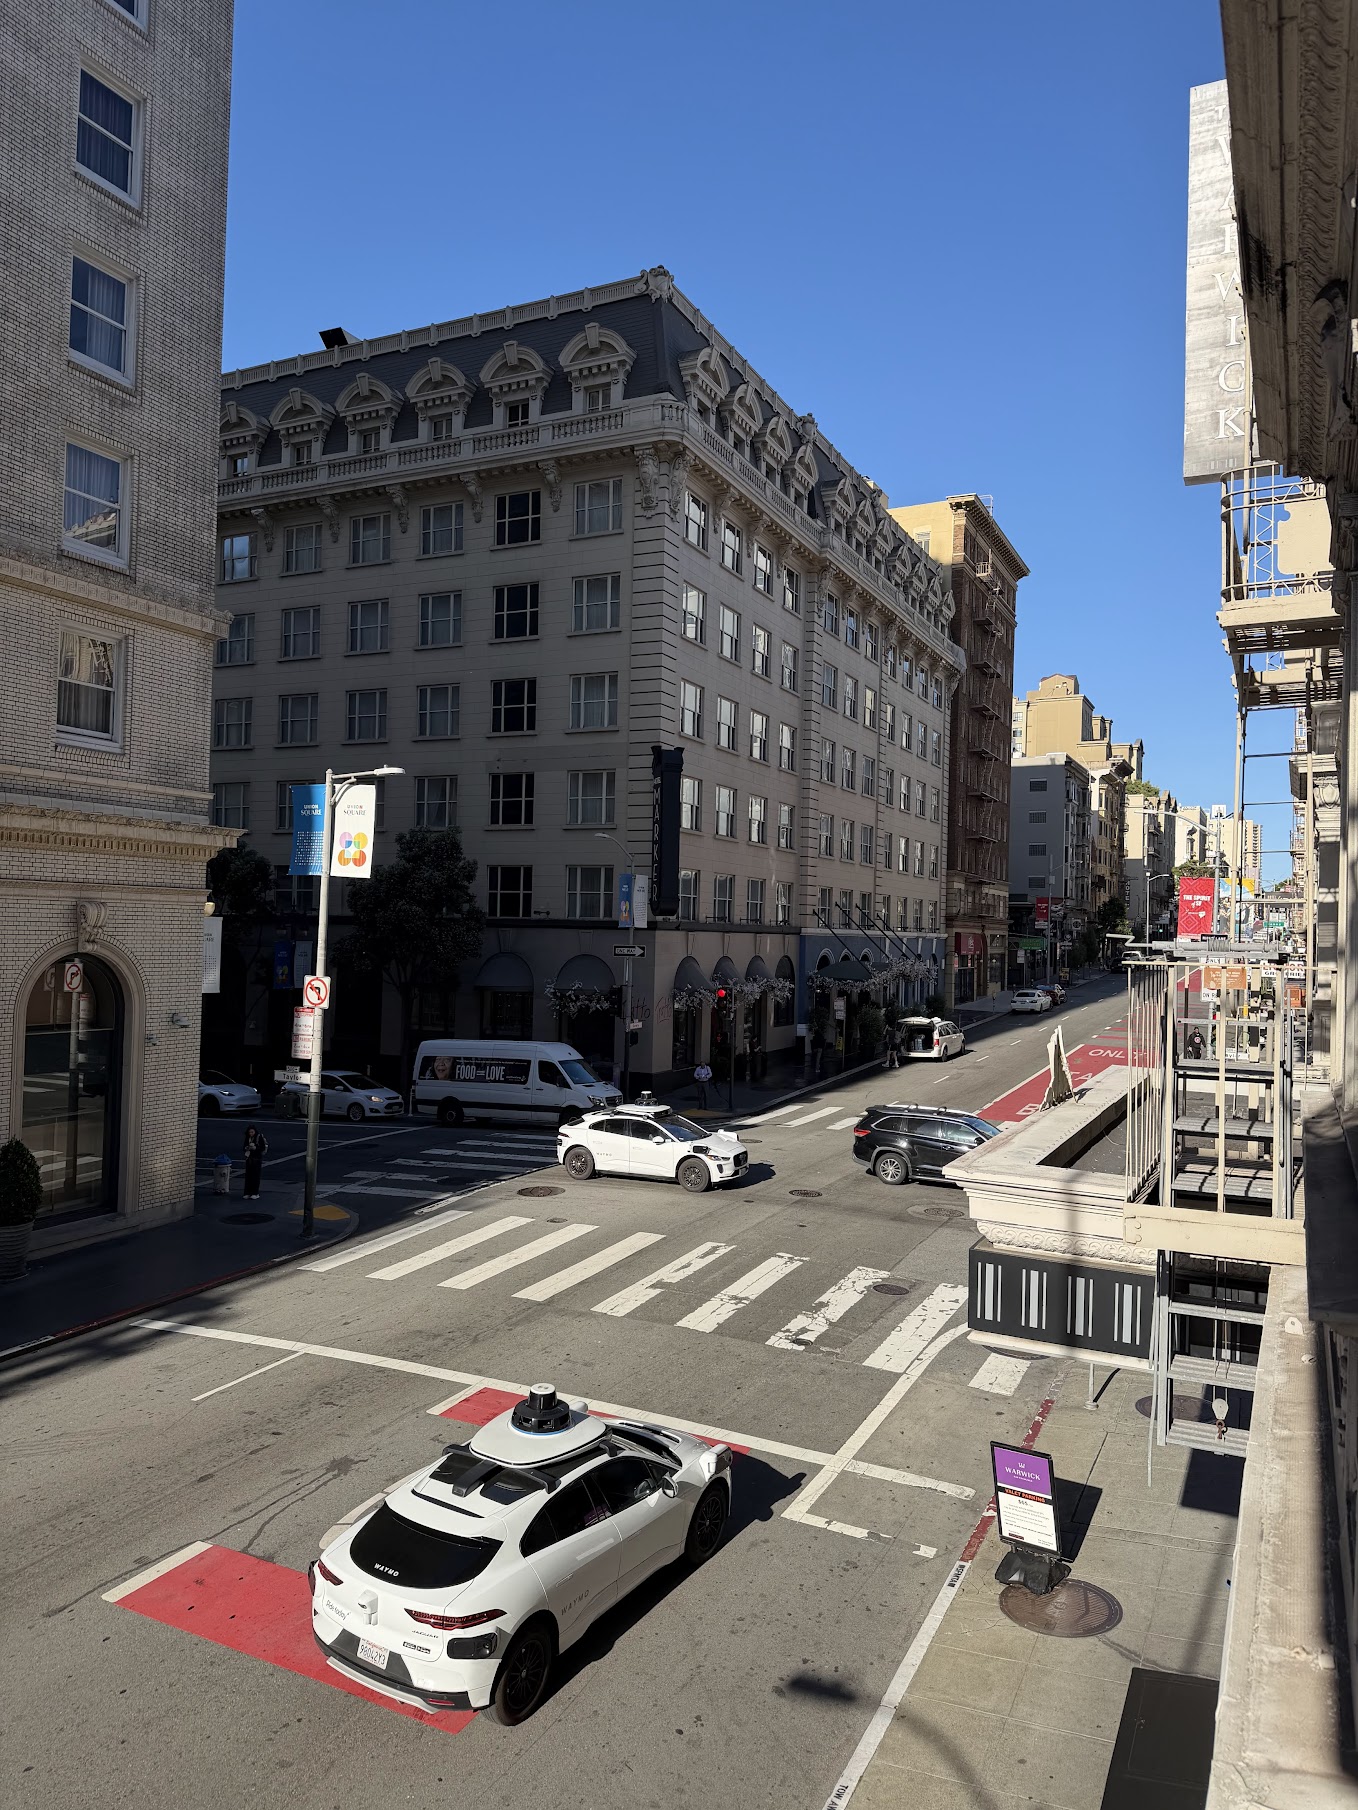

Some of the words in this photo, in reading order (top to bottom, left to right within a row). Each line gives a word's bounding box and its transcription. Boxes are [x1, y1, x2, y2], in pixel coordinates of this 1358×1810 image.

[300, 808, 322, 816] SQUARE
[652, 786, 661, 902] MARKER
[455, 1064, 476, 1080] FOOD
[486, 1065, 506, 1081] LOVE
[1004, 1466, 1041, 1481] WARWICK
[1004, 1488, 1021, 1497] VALET
[1021, 1492, 1046, 1503] PARKING
[374, 1562, 400, 1578] WAYMO
[561, 1589, 590, 1616] WAYMO
[411, 1629, 439, 1640] JAGUAR
[833, 1784, 849, 1801] TOW
